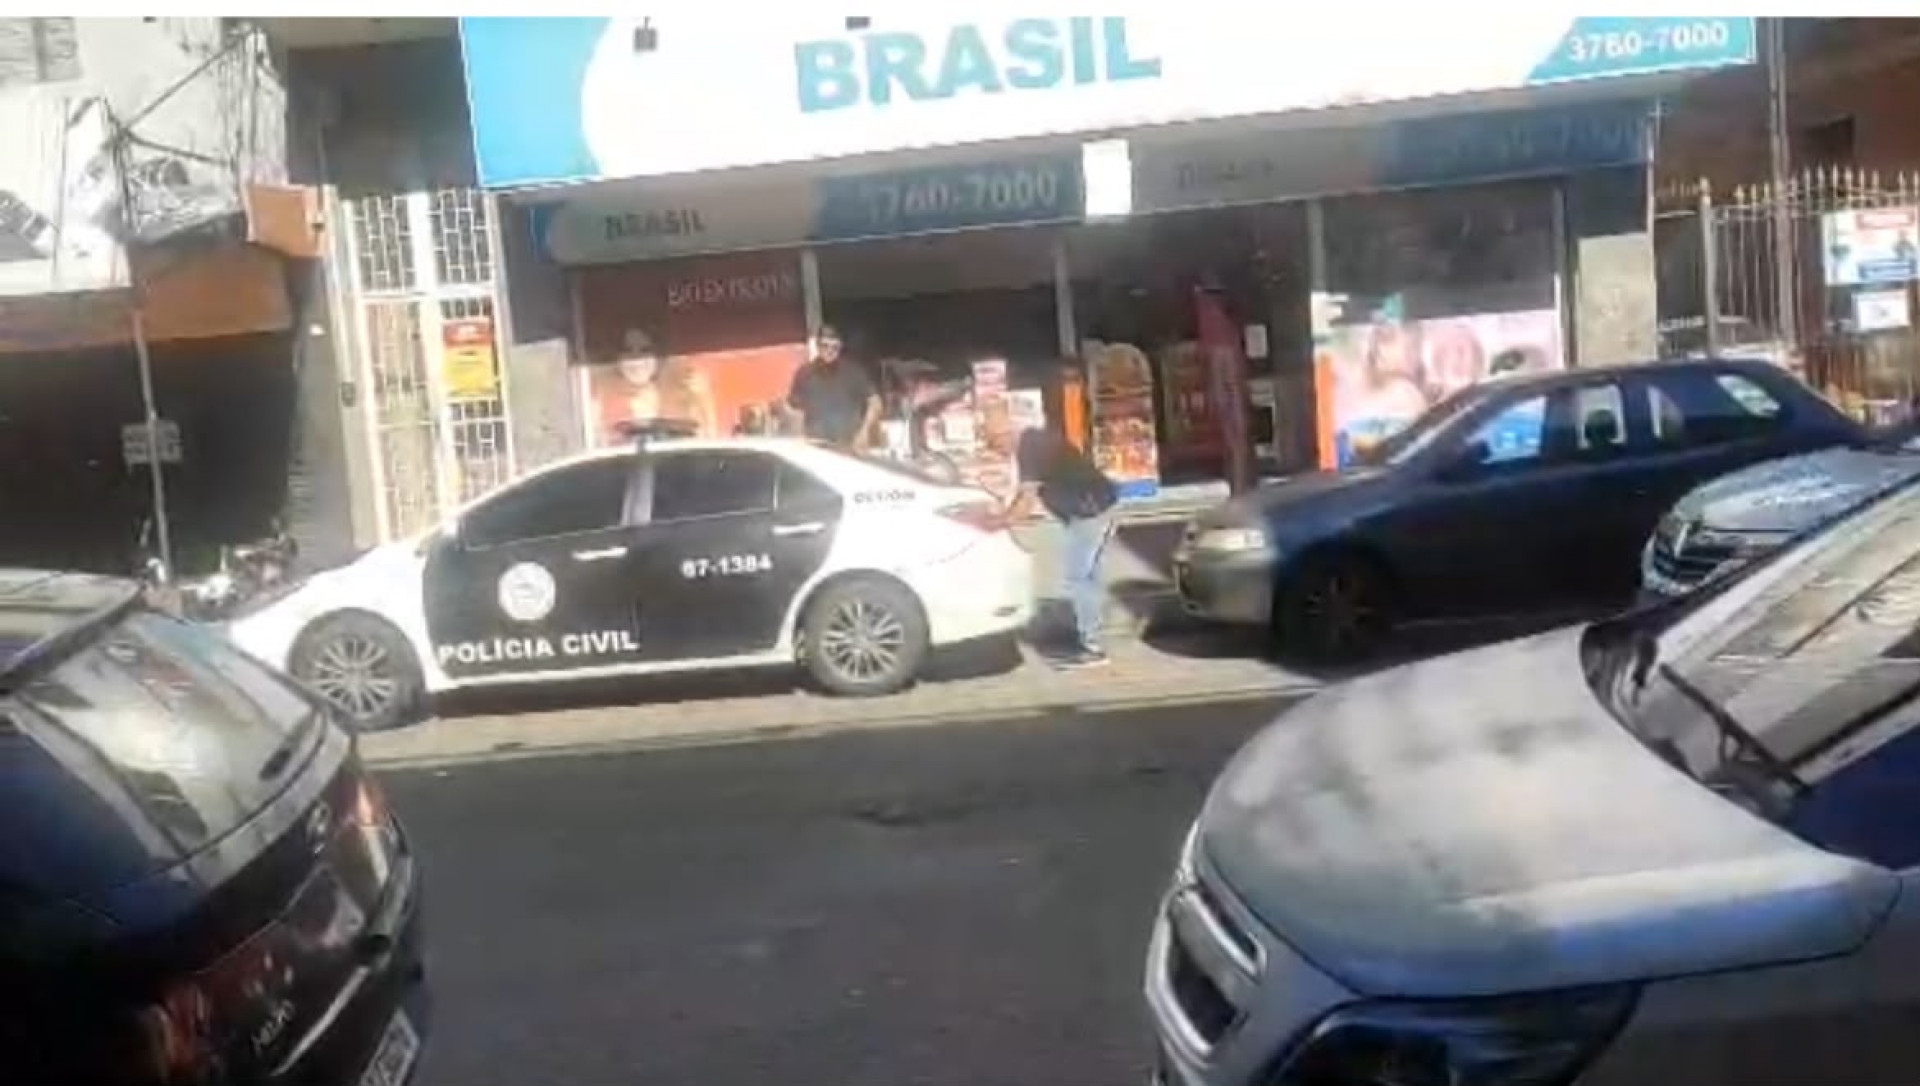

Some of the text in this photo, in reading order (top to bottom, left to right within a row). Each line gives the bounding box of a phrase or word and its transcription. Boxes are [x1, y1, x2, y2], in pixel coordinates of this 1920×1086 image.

[1567, 20, 1729, 62] 3760-7000
[795, 16, 1162, 114] BRASIL
[561, 629, 641, 655] CIVIL
